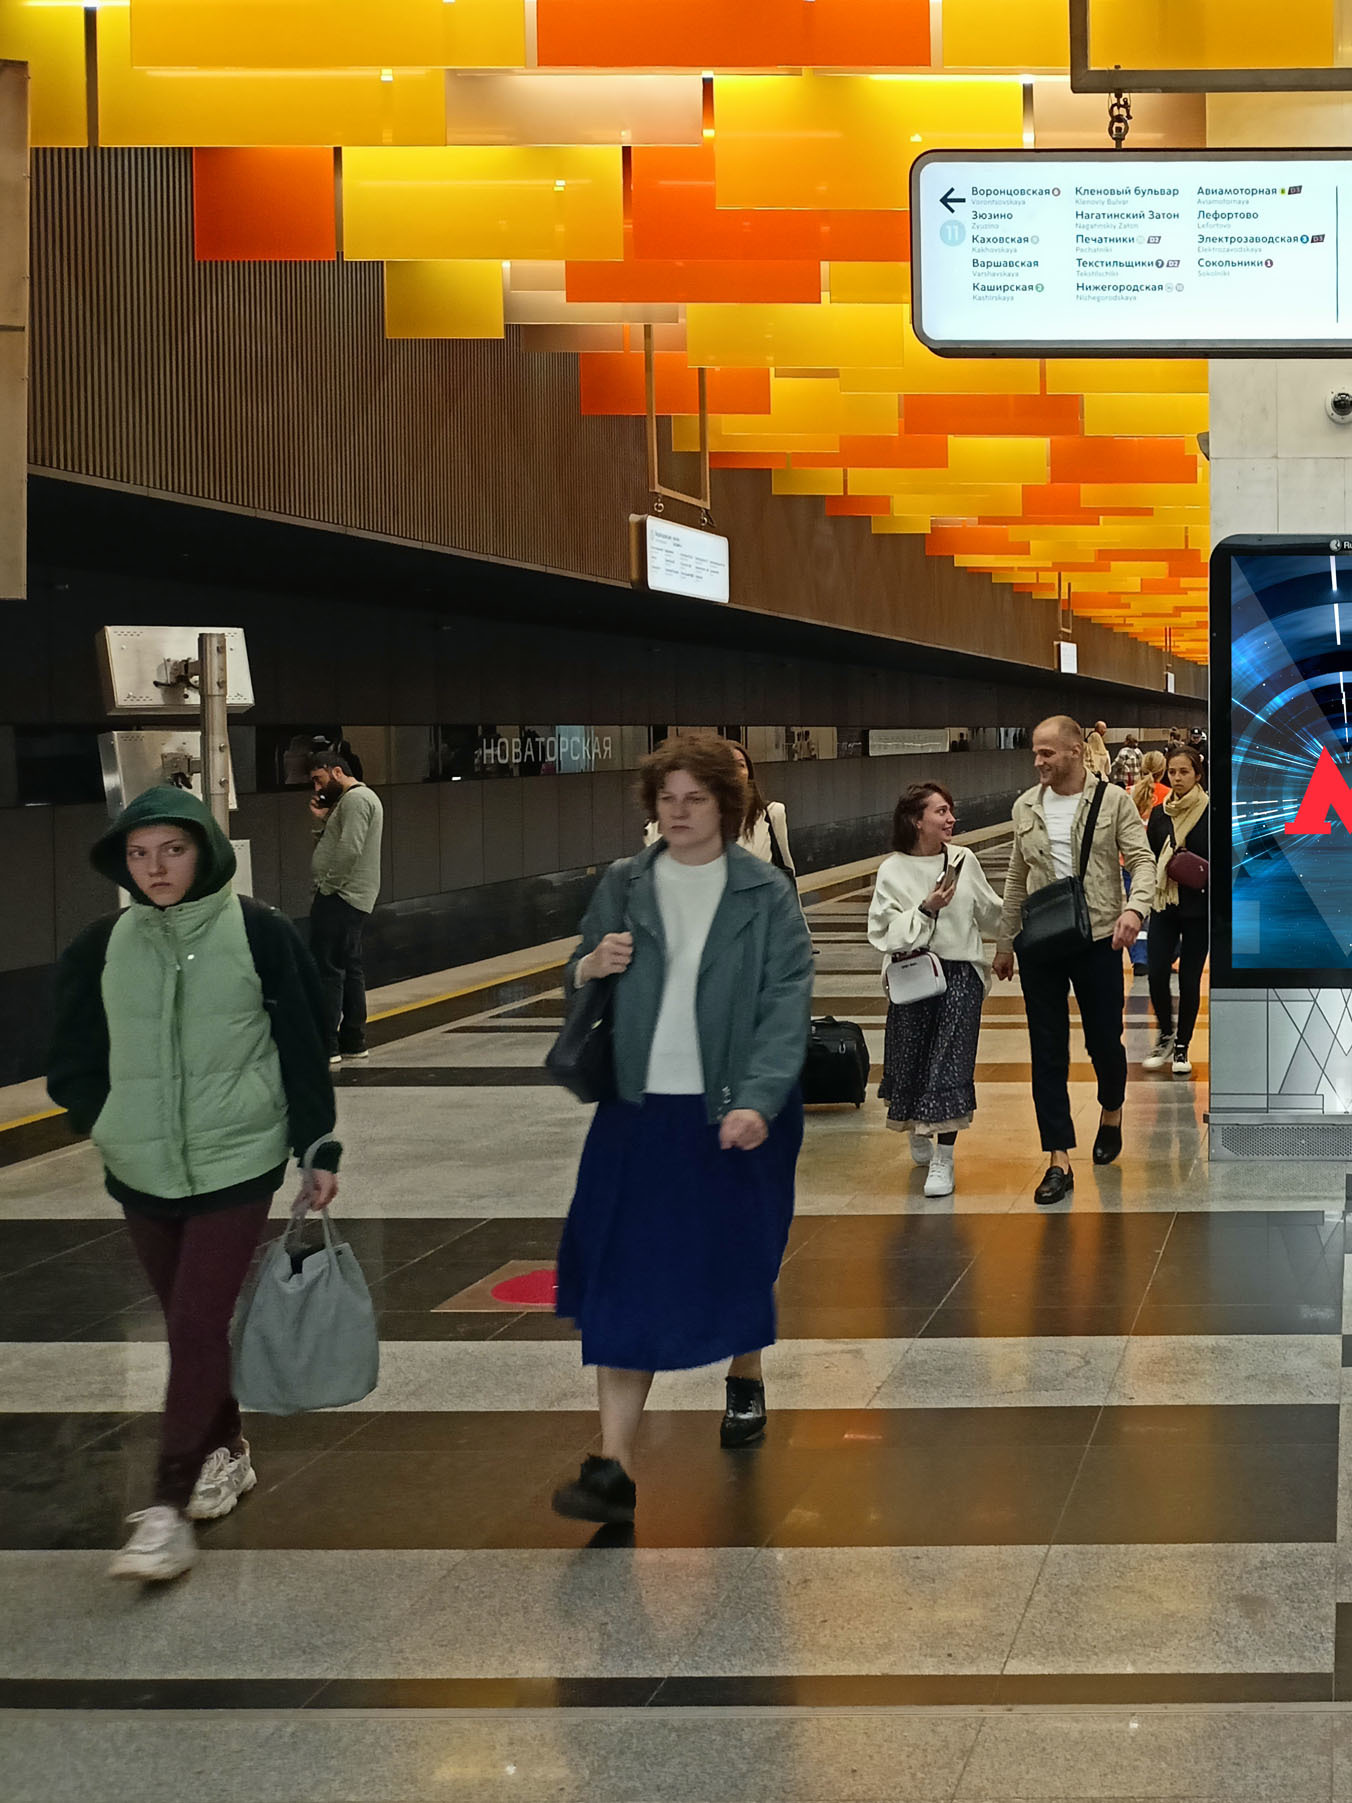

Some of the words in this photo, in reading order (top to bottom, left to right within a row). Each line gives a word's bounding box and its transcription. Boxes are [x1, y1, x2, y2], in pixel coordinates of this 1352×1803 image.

[971, 186, 1051, 198] Воронцовская
[1075, 186, 1131, 196] Кленовый
[1134, 186, 1179, 197] бульвар
[1197, 186, 1277, 196] Авиамоторная
[971, 210, 1013, 220] Зюзино
[1075, 210, 1145, 220] Нагатинский
[1148, 210, 1179, 220] Затон
[1197, 209, 1259, 221] Лефортово
[972, 234, 1029, 244] Каховская
[1076, 234, 1135, 244] Печатники
[1197, 234, 1298, 245] Электрозаводская
[972, 258, 1039, 269] Варшавская
[1076, 258, 1153, 268] Текстильщики
[1197, 257, 1263, 267] Сокольники
[972, 282, 1034, 293] Каширская
[1076, 282, 1163, 293] Нижегородская
[482, 736, 612, 765] НОВАТОРСКАЯ
